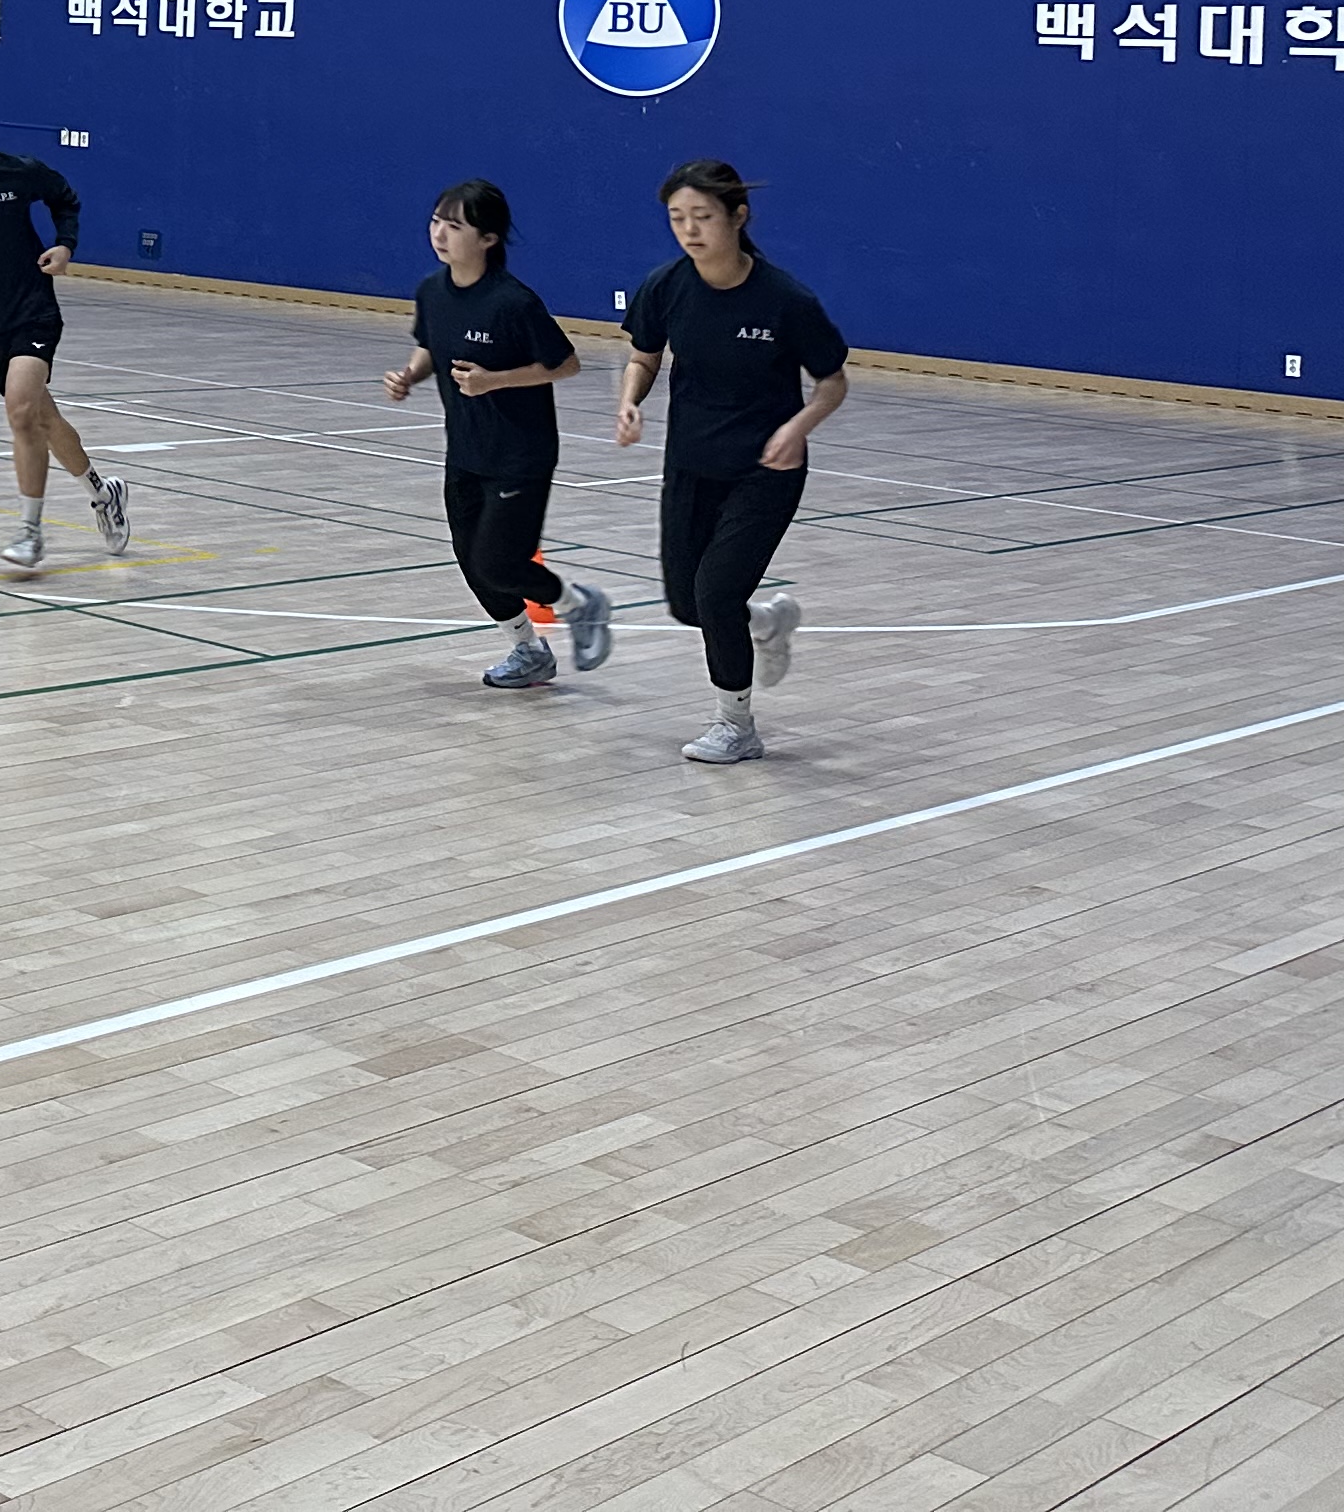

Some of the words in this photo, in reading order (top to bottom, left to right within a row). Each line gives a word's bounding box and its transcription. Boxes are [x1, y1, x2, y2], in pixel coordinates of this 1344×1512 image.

[608, 1, 667, 34] BU
[464, 329, 494, 344] A.P.E.
[736, 326, 775, 342] A.P.E.
